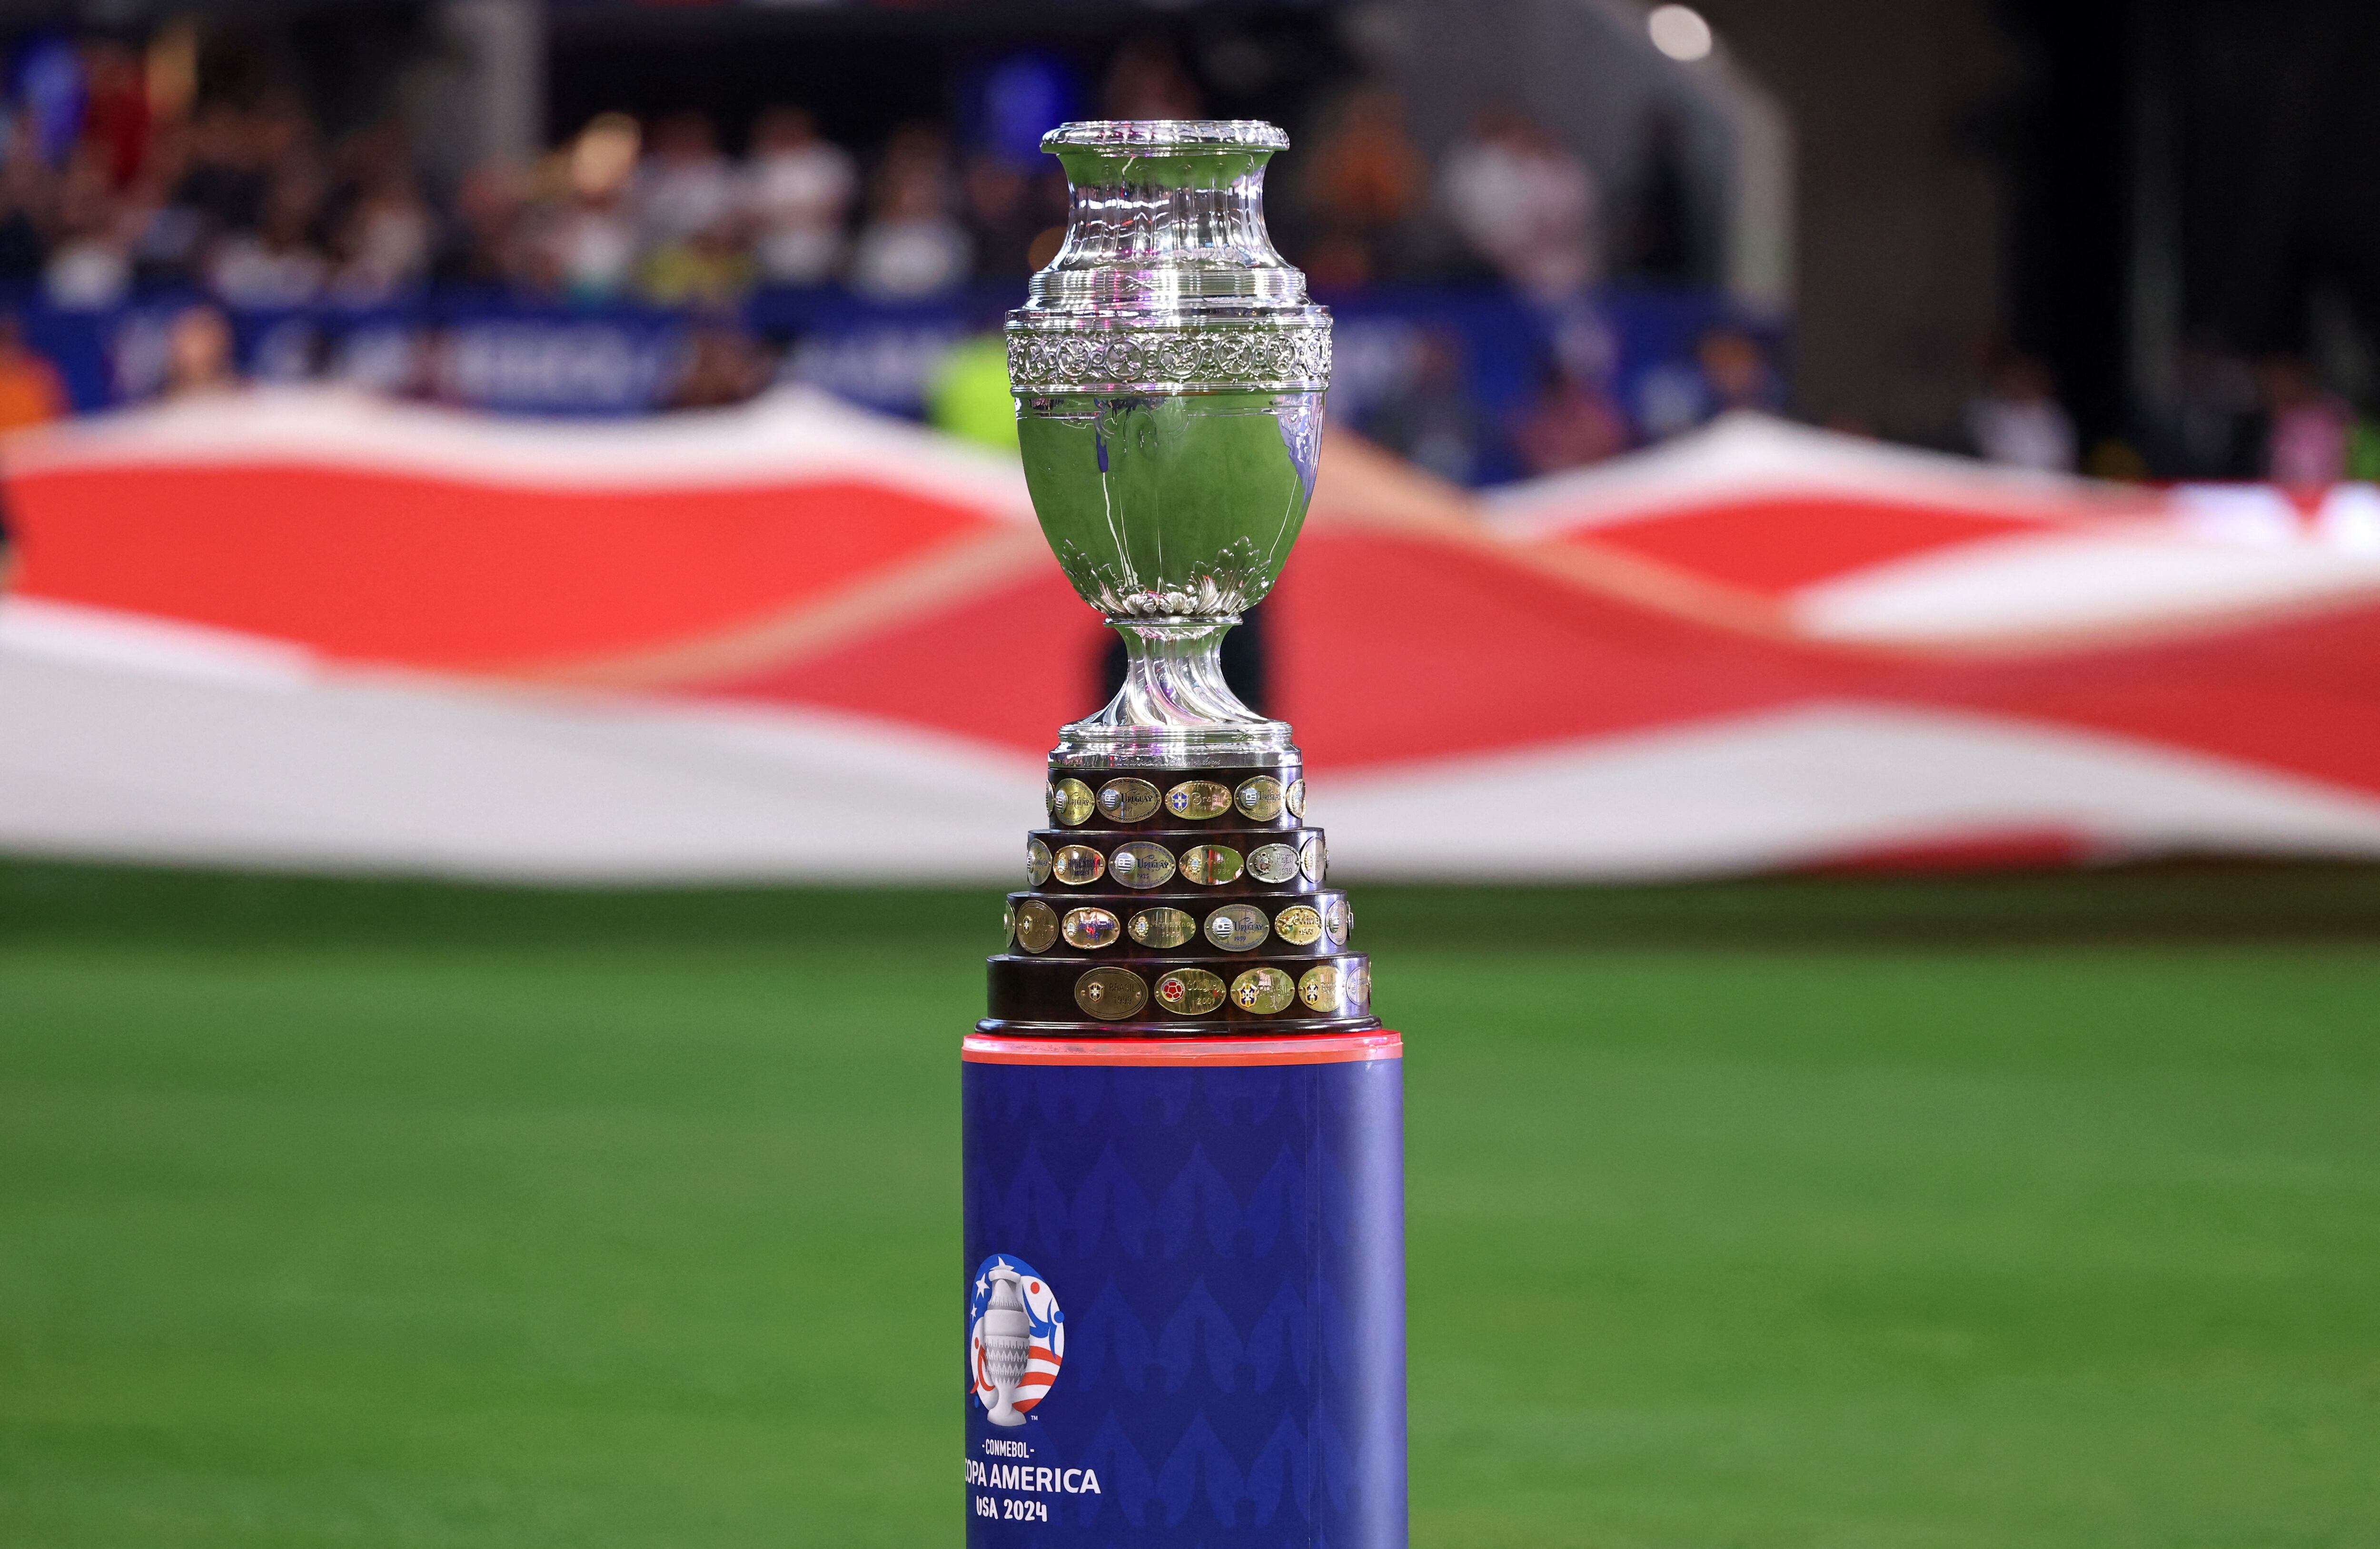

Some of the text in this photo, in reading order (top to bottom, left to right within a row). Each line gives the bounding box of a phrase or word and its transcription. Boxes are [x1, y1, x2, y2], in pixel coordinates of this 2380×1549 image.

[1278, 868, 1292, 876] 1939
[1109, 983, 1137, 992] BRASIL
[1113, 996, 1131, 1005] 1999
[990, 1463, 1101, 1494] AMERICA
[976, 1495, 1047, 1522] USA 2024
